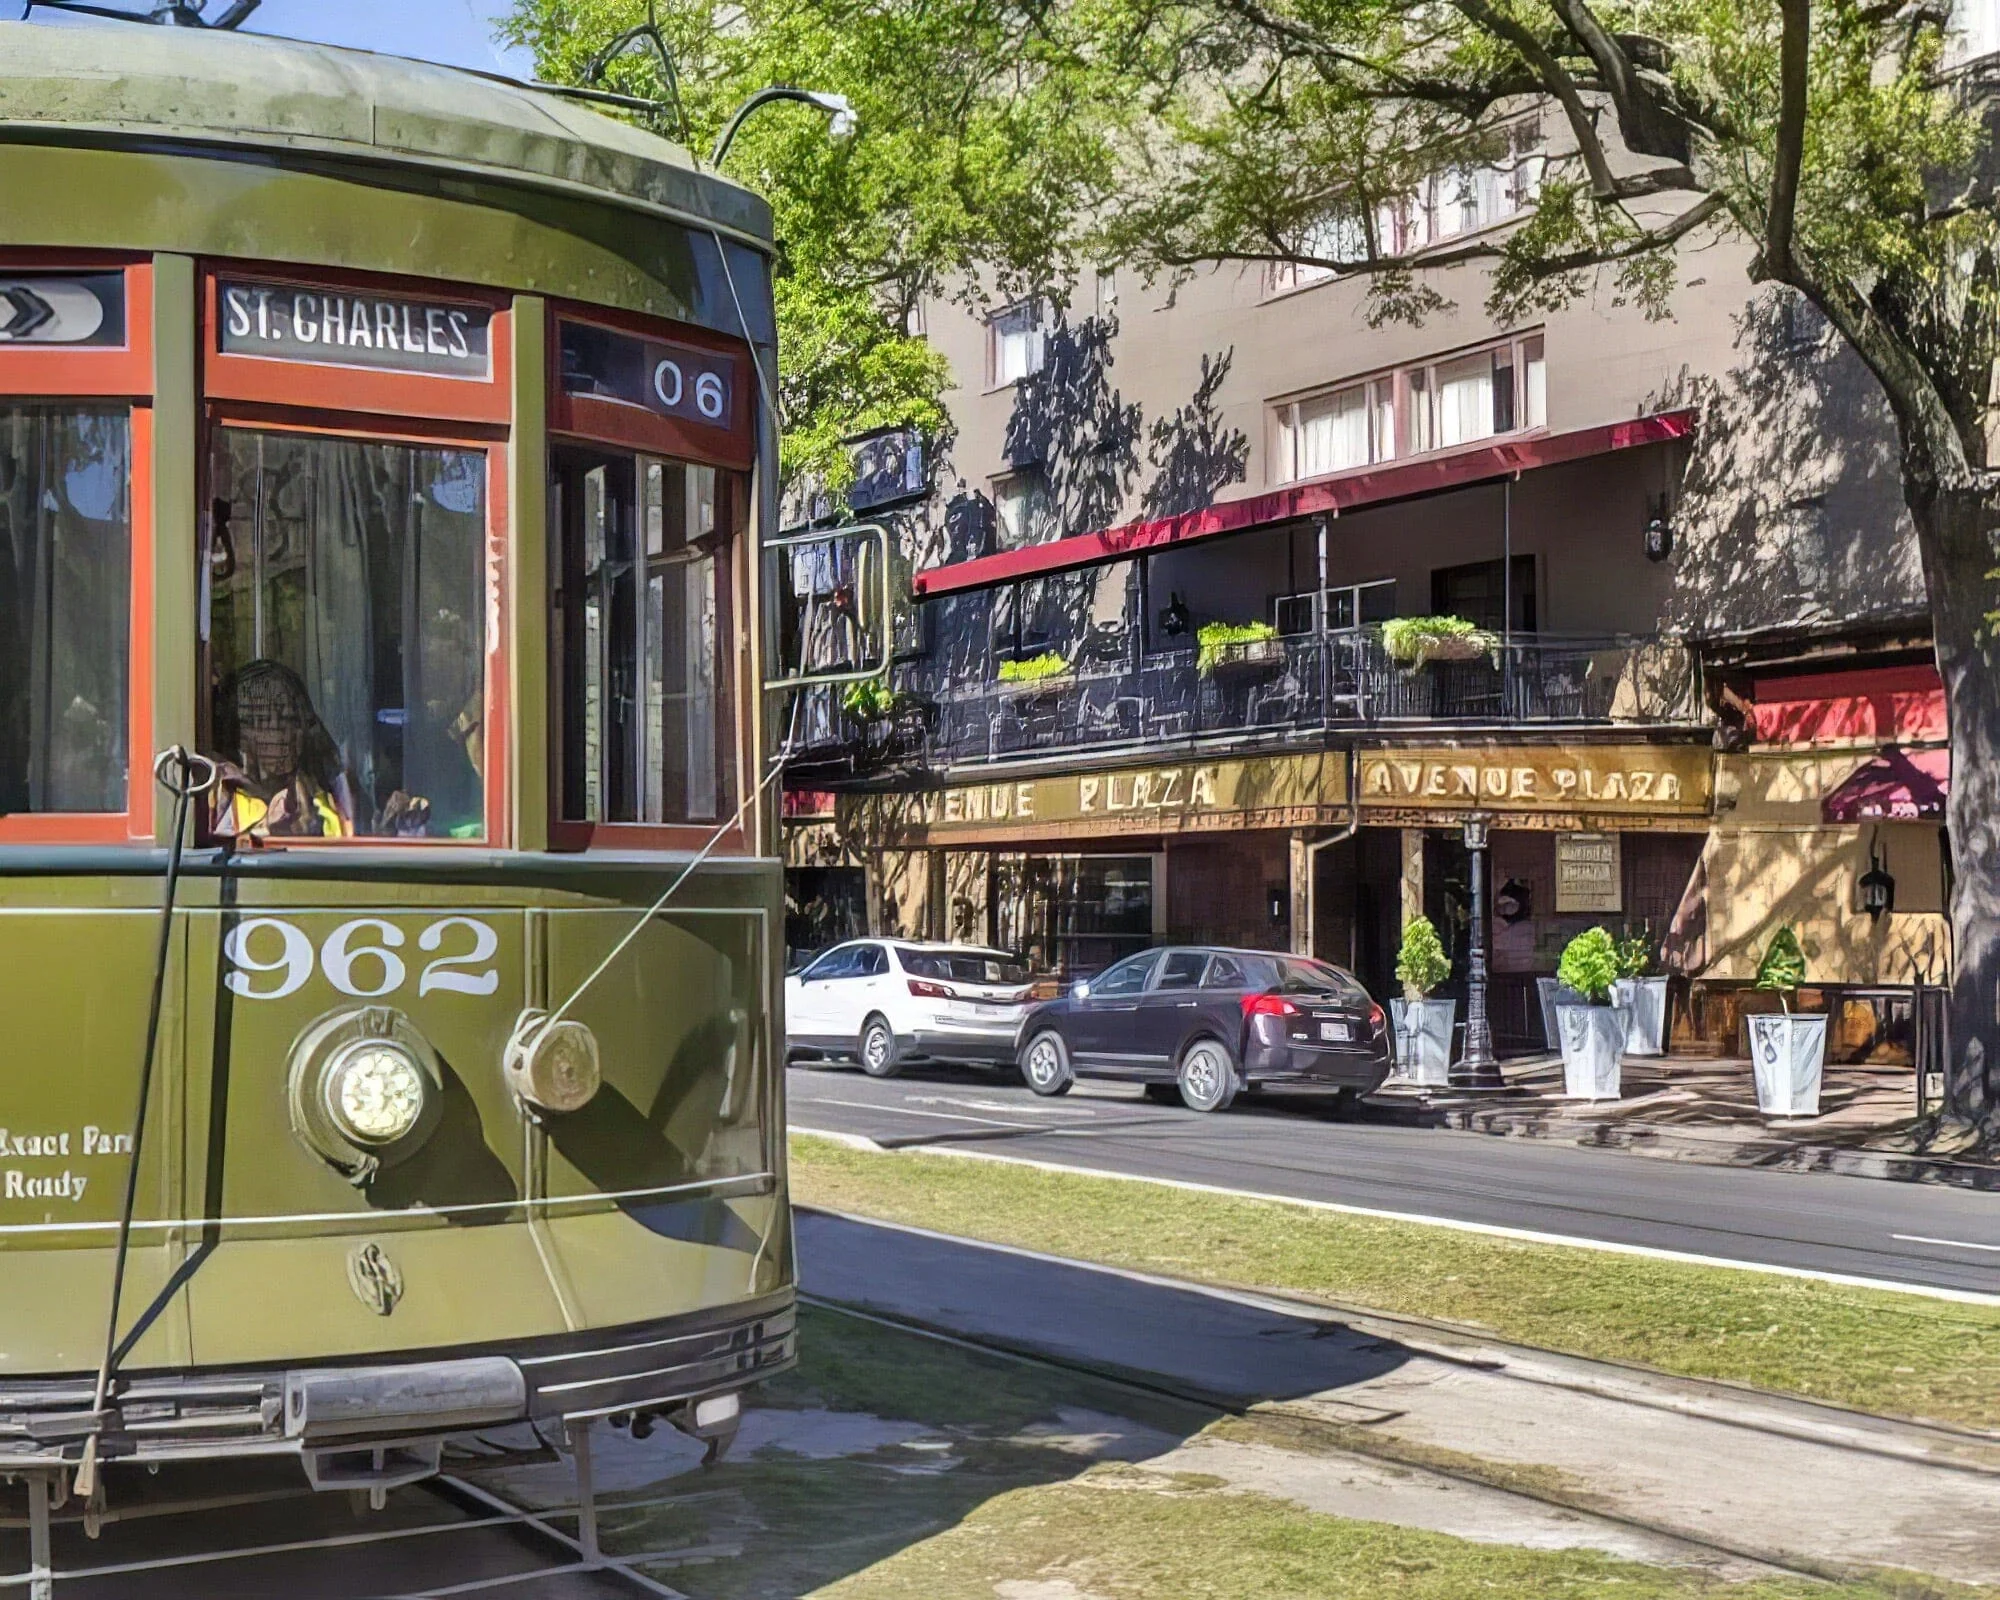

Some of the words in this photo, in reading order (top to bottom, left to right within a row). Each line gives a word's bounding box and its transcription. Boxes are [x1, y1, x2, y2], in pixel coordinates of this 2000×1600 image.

[227, 287, 281, 340] ST.
[293, 294, 469, 358] CHARLES
[654, 359, 723, 419] 06
[1079, 766, 1216, 813] PLAZA
[1366, 763, 1538, 799] AVENUE
[1552, 768, 1681, 802] PLAZA
[224, 917, 499, 1000] 962
